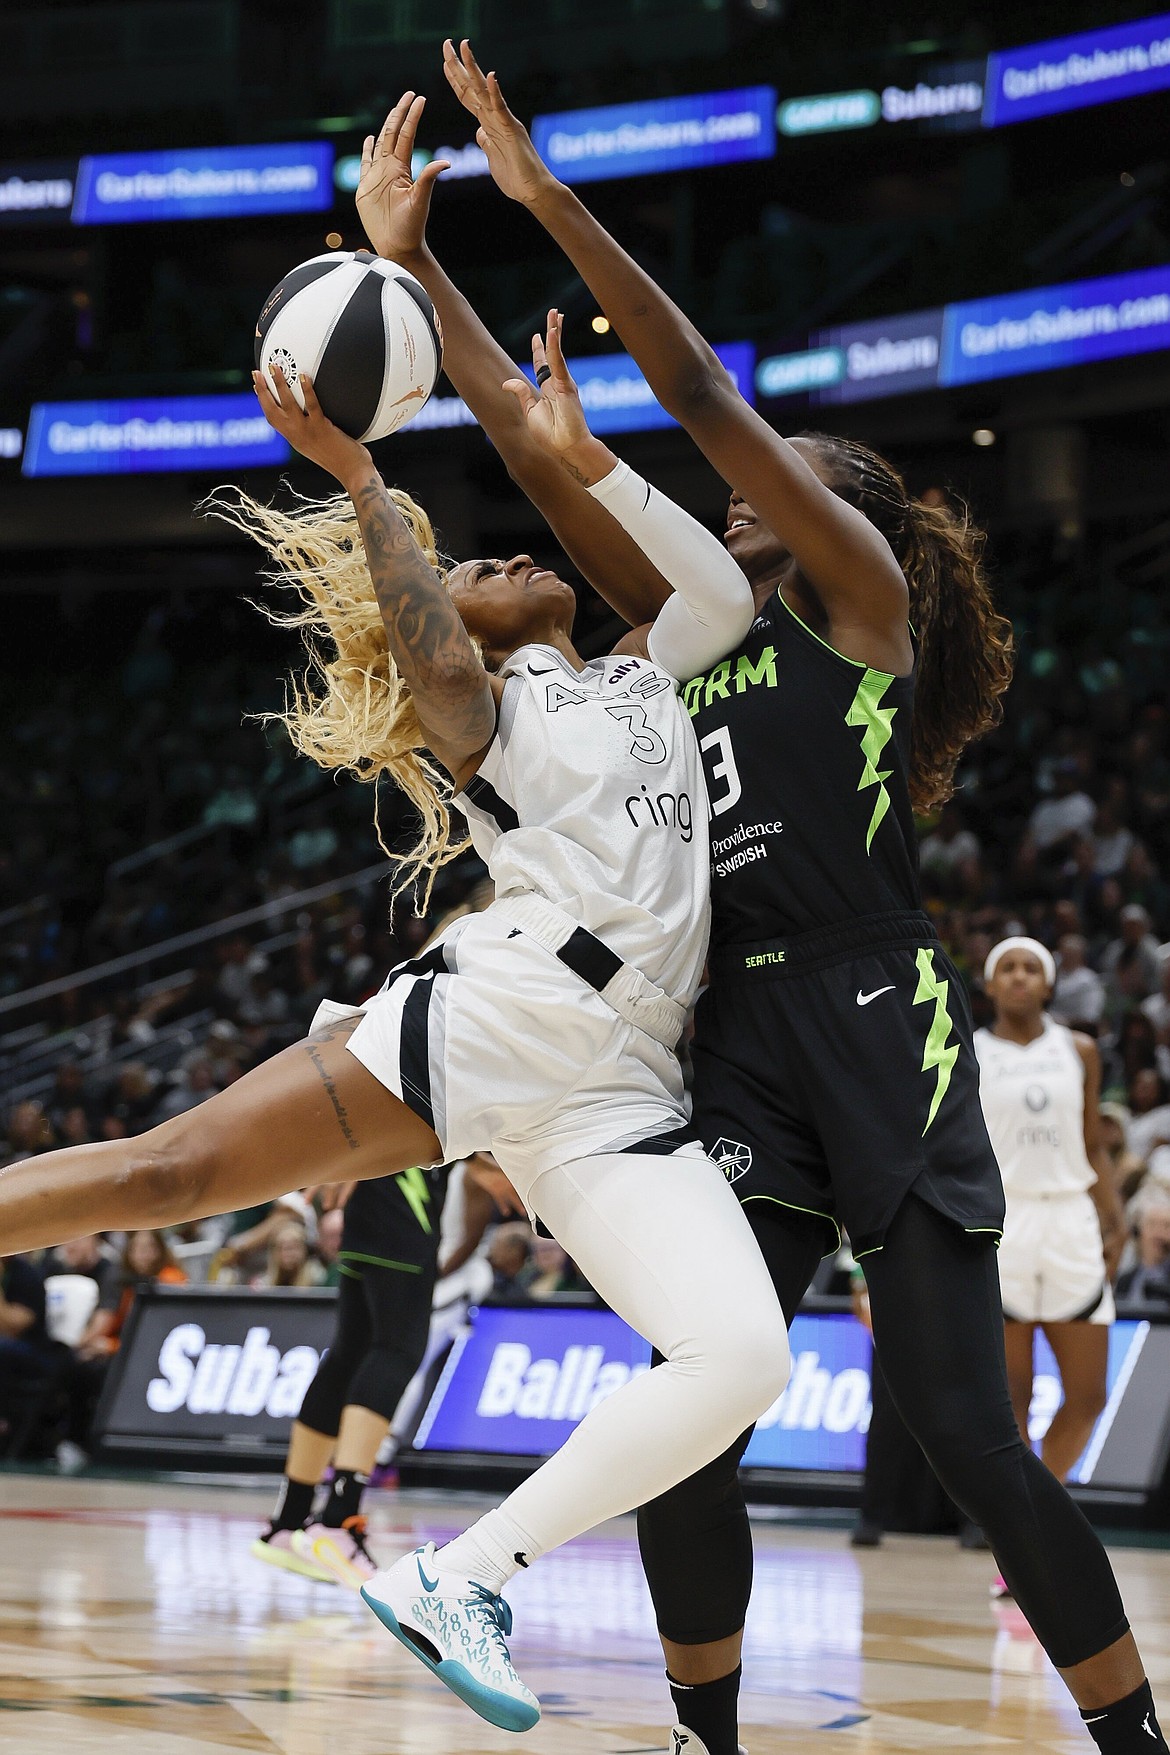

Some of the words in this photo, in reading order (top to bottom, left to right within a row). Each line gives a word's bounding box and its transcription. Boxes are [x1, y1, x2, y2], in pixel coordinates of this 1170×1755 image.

[608, 659, 641, 685] ally
[677, 645, 778, 718] ORM
[605, 704, 667, 765] 3
[700, 725, 742, 822] 3
[625, 785, 693, 843] ring
[711, 820, 784, 858] Providence
[716, 843, 768, 878] SWEDISH
[745, 951, 786, 968] SEATTLE
[146, 1323, 329, 1418] Suba
